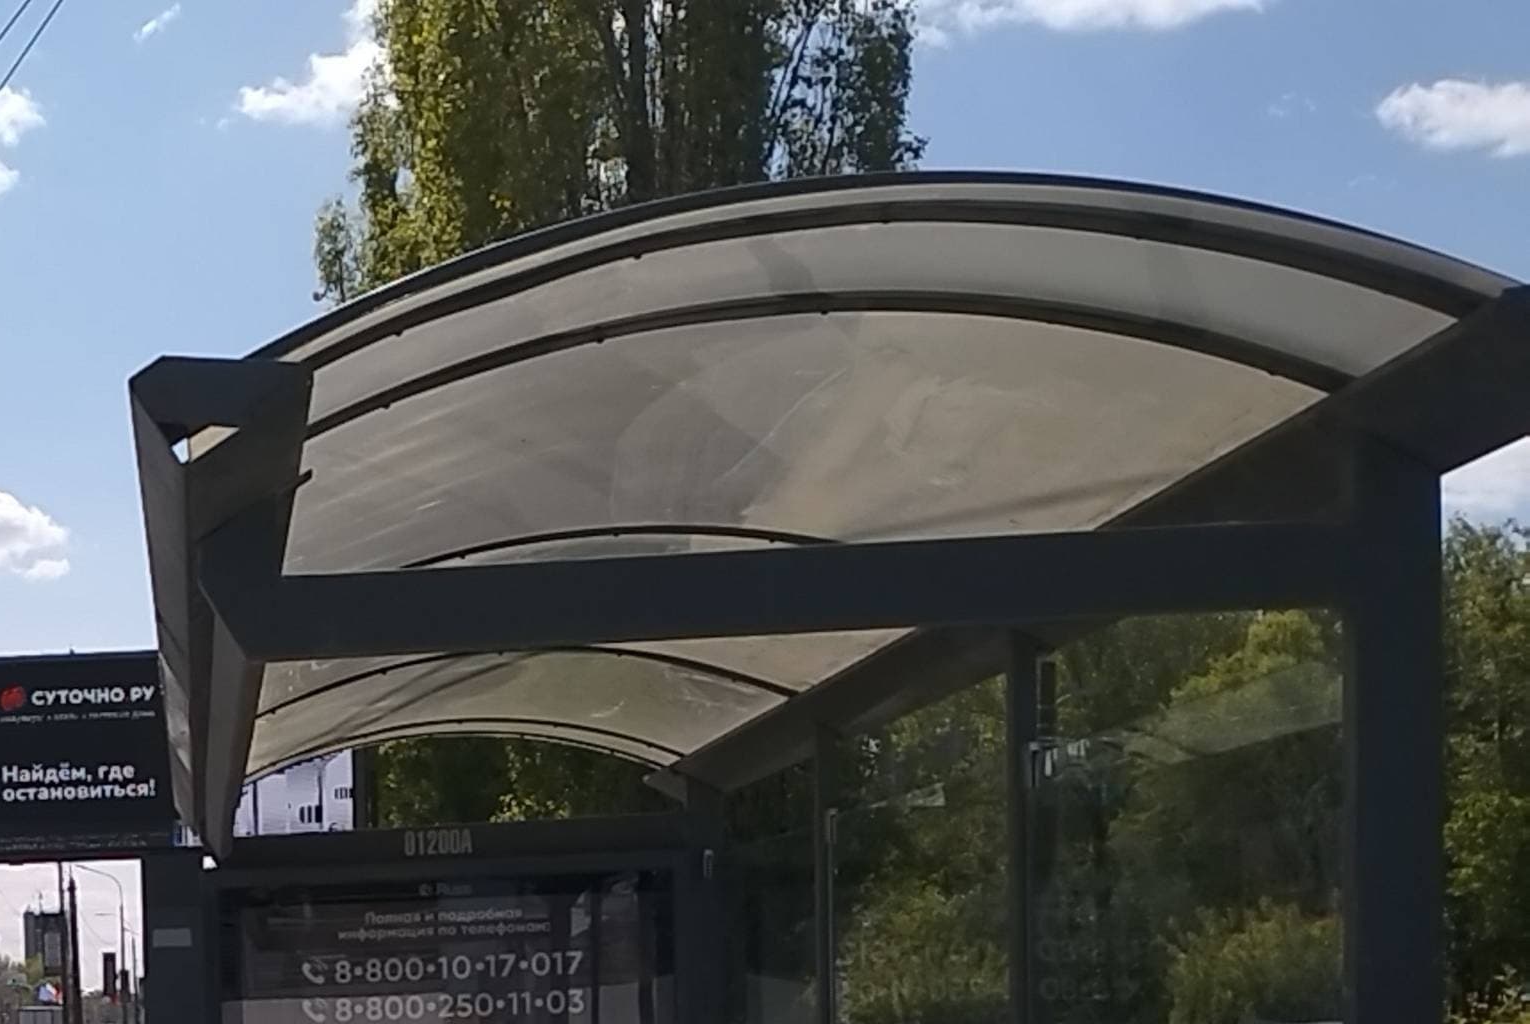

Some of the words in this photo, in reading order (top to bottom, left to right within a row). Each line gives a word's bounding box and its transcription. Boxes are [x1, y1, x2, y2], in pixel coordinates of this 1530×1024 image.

[1, 763, 92, 784] Найдём,
[97, 764, 135, 782] где
[2, 778, 156, 802] остановиться!
[364, 910, 421, 926] Полная
[437, 907, 523, 925] подробная
[337, 926, 434, 943] информация
[437, 925, 456, 936] по
